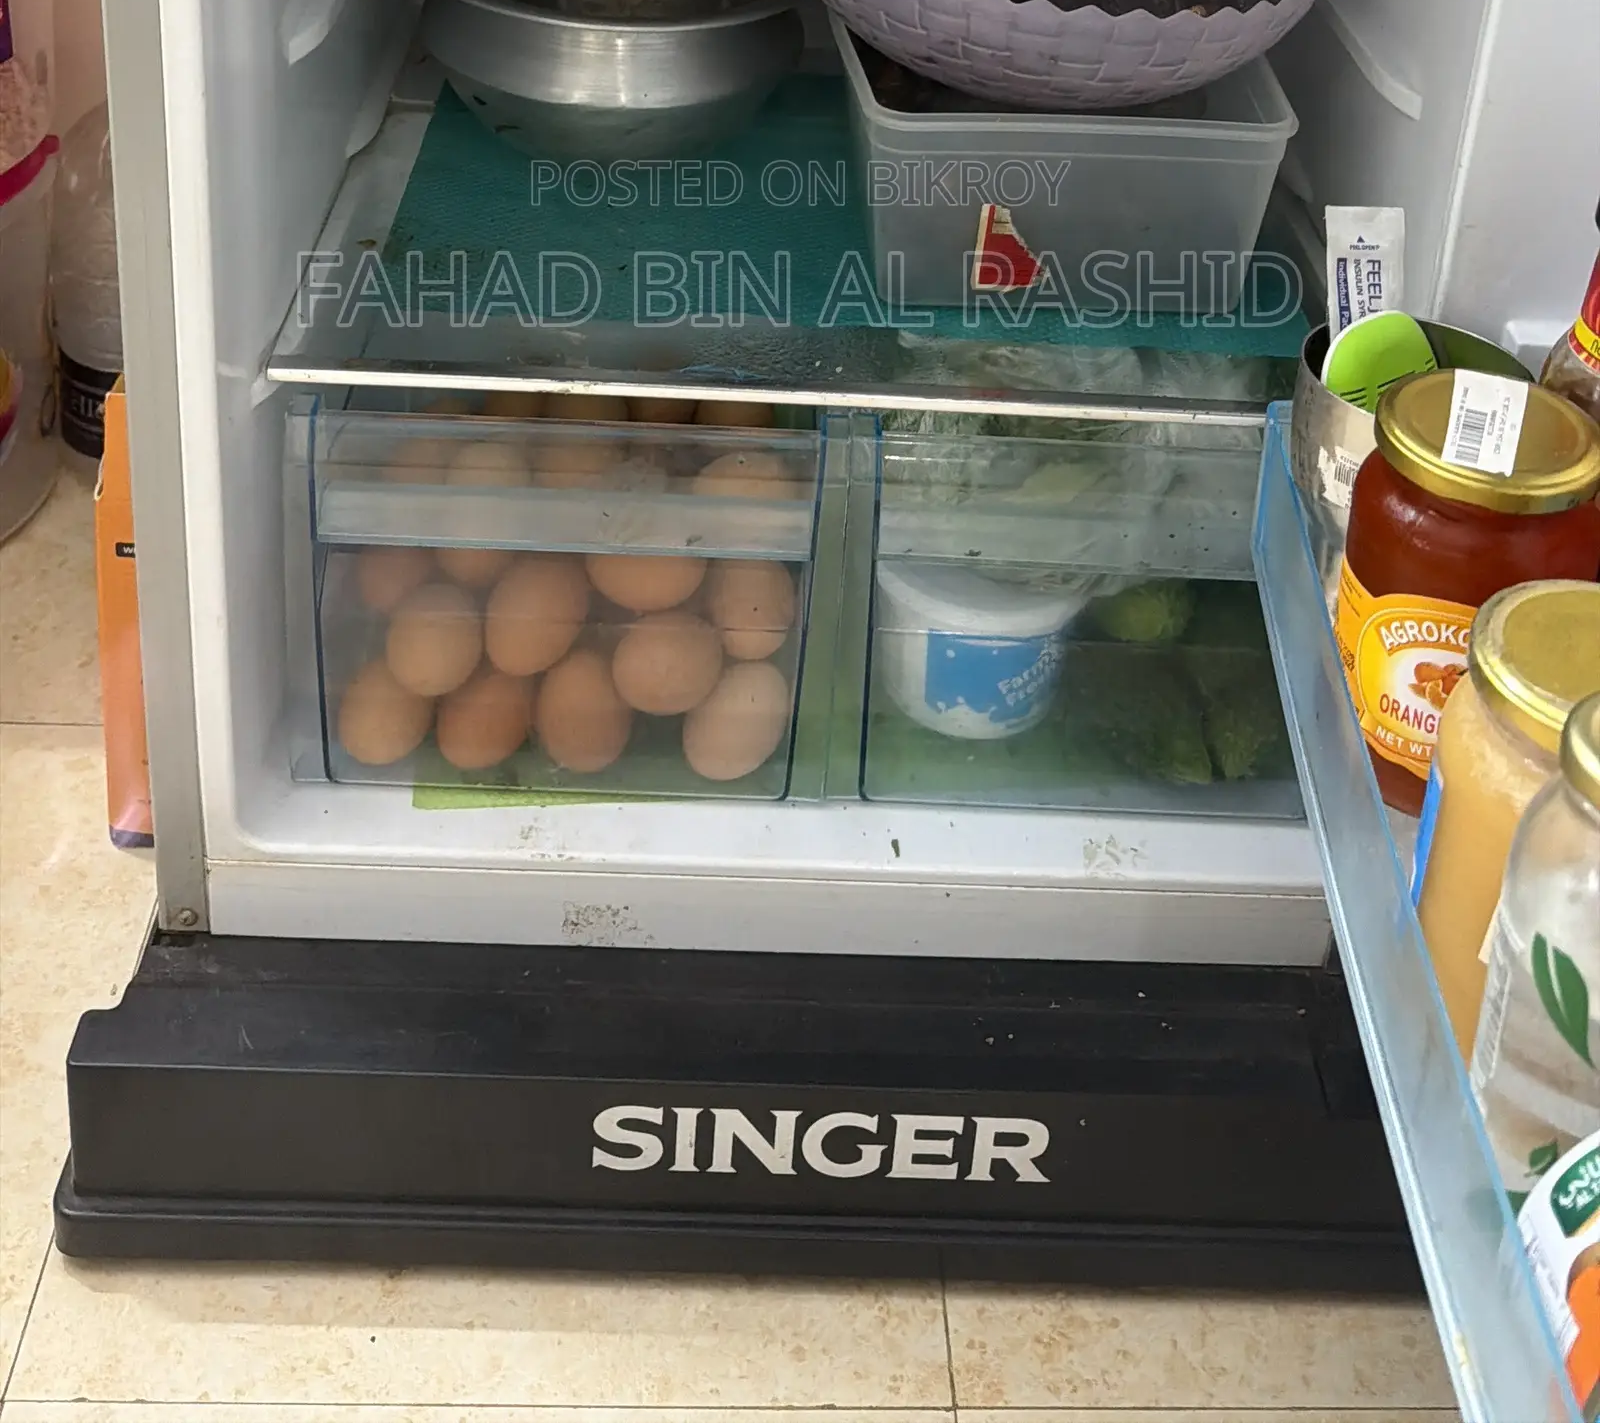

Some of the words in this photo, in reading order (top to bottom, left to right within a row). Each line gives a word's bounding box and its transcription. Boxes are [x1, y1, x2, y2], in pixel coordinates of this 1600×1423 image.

[1338, 261, 1349, 307] Individual
[1353, 259, 1364, 296] INSULIN
[1366, 259, 1382, 313] FEELJ
[1341, 310, 1350, 329] Pac
[1357, 299, 1367, 319] SYR
[1380, 693, 1438, 735] ORANG
[1376, 725, 1404, 749] NET
[1409, 741, 1433, 757] WT
[592, 1105, 1051, 1183] SINGER
